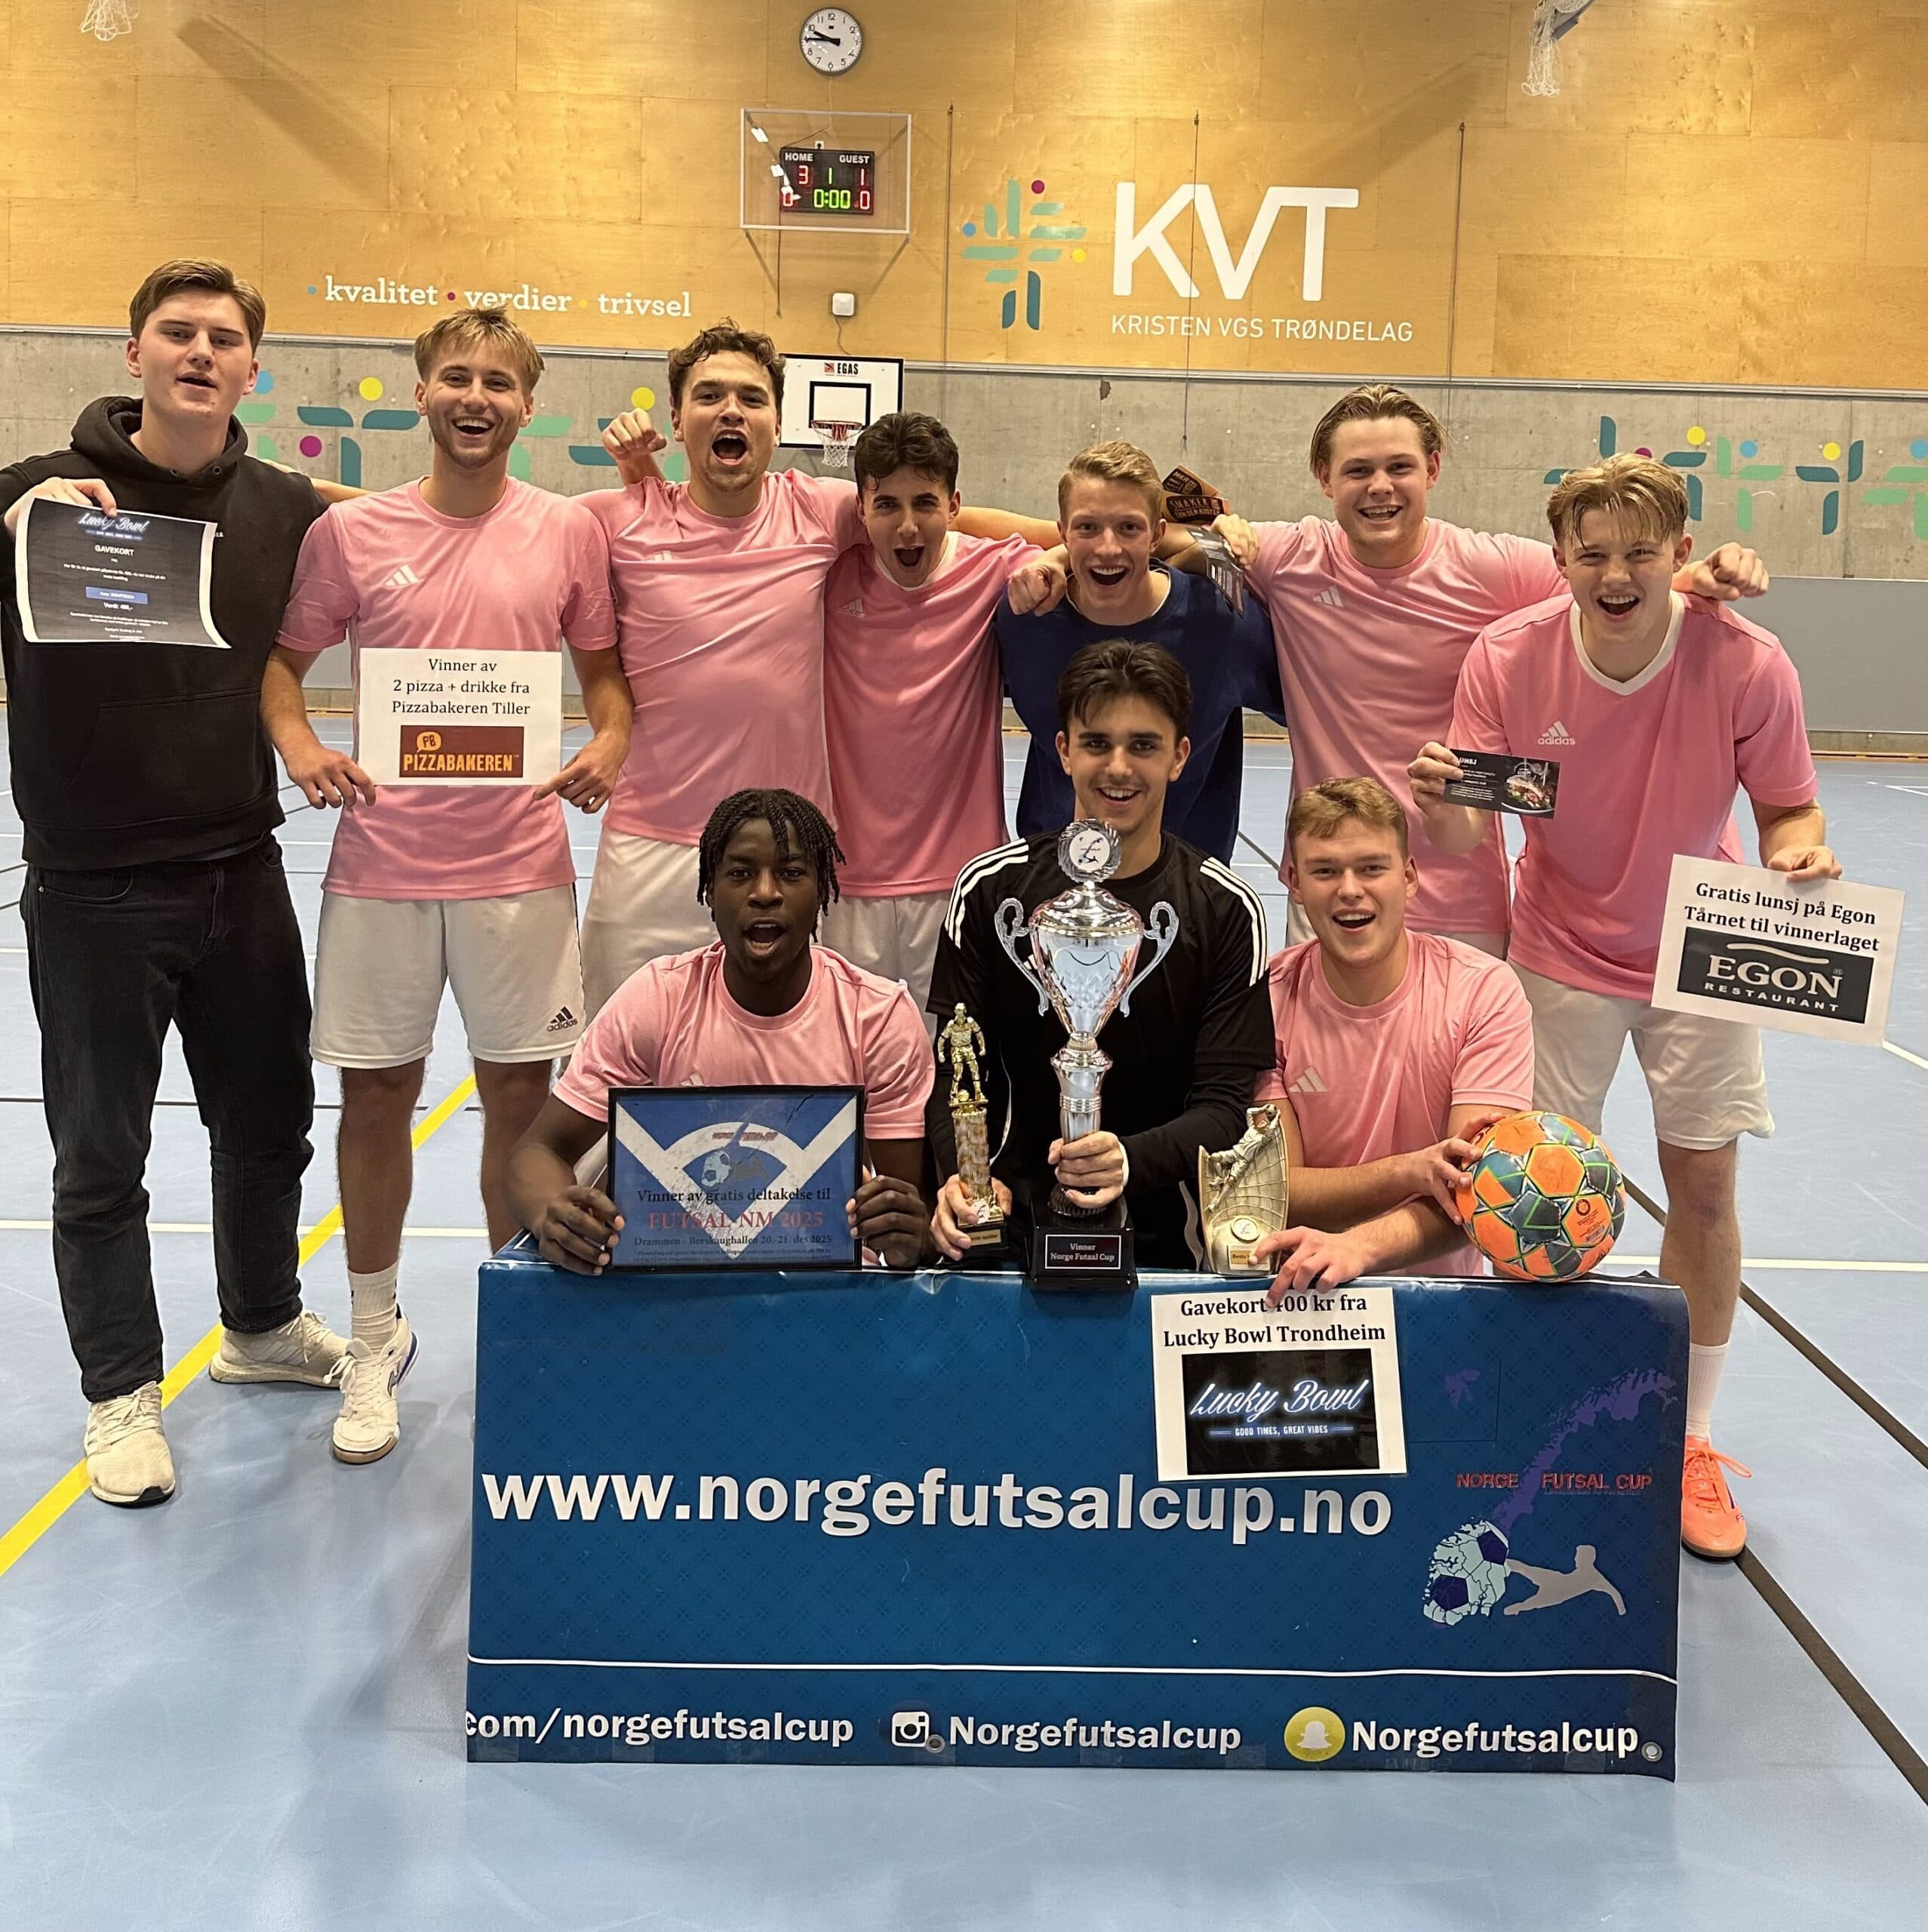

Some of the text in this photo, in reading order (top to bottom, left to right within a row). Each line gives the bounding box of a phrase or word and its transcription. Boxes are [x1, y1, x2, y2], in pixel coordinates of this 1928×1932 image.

[785, 152, 869, 164] HOME GUEST
[798, 165, 865, 186] 3 1 1
[813, 189, 850, 208] 0:00
[859, 190, 870, 209] 0
[1113, 181, 1358, 301] KVT
[325, 275, 691, 317] kvalitet verdier trivsel
[1112, 315, 1413, 343] KRISTEN VGS TRØNDELAG
[838, 362, 859, 374] EGAS
[78, 512, 150, 532] Lucky Bowl
[95, 544, 135, 556] GAVEKORT
[429, 658, 497, 671] Vinner av
[393, 679, 530, 694] 2 pizza + drikke fra
[392, 701, 530, 714] Pizzabakeren Tiller
[423, 734, 436, 747] PB
[1537, 737, 1576, 746] adidas
[404, 755, 513, 771] PIZZABAKEREN
[1696, 883, 1876, 924] Gratis lunsj på Egon
[1684, 906, 1880, 952] Tårnet til vinnerlaget
[1707, 955, 1843, 998] EGON
[1705, 983, 1839, 1012] RESTAURANT
[546, 1019, 578, 1032] adidas
[637, 1188, 832, 1204] Vinner av gratis deltakelse til
[648, 1211, 823, 1229] FUTSAL NM 2025
[810, 1235, 832, 1244] 2025
[1050, 1253, 1074, 1261] Norge
[1099, 1254, 1115, 1262] Cup
[1181, 1297, 1268, 1316] Gavekort
[1314, 1294, 1335, 1312] kr
[1339, 1294, 1367, 1312] fra
[1164, 1324, 1385, 1349] Lucky Bowl Trondheim
[1189, 1379, 1369, 1423] Lucky Bowl
[1235, 1425, 1328, 1437] GOOD TIMES, GREAT VIBES
[1455, 1472, 1653, 1490] NORGE FUTSAL CUP
[481, 1468, 1391, 1545] www.norgefutsalcup.no
[949, 1716, 1241, 1755] Norgefutsalcup
[1353, 1721, 1638, 1758] Norgefutsalcup
